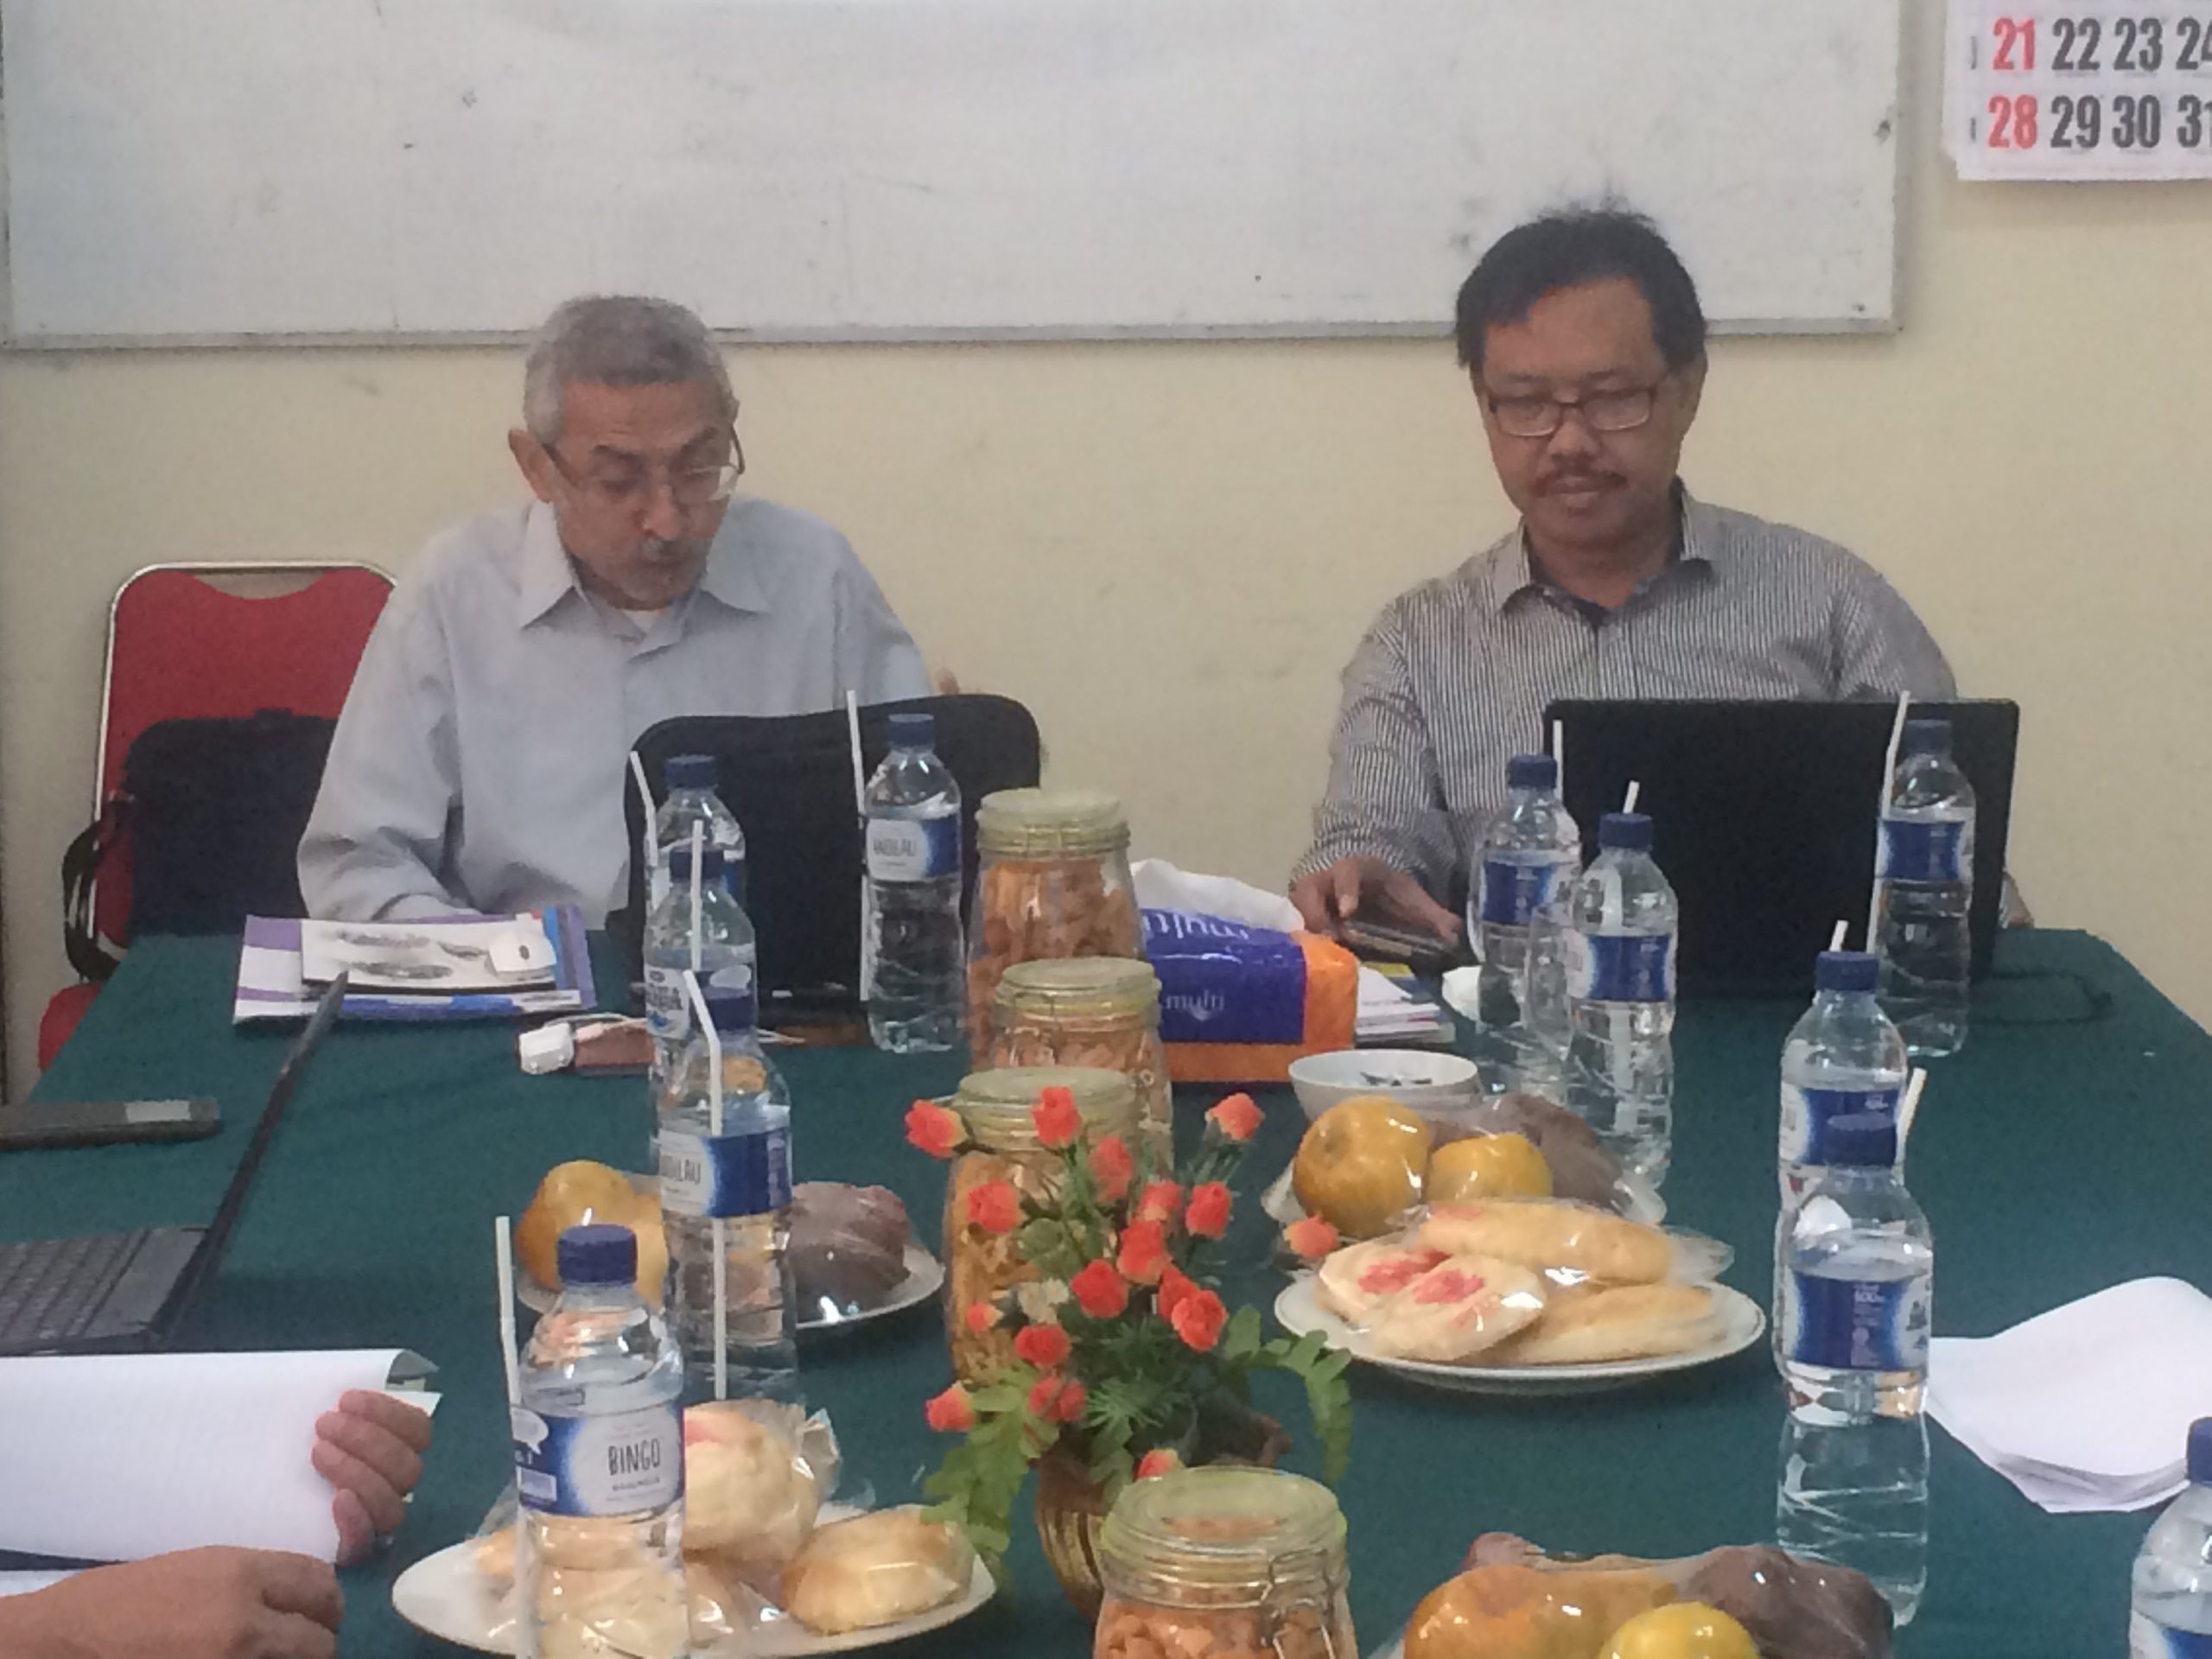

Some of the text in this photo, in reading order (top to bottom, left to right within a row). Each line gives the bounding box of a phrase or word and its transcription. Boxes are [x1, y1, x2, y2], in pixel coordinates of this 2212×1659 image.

[1992, 16, 2036, 71] 21
[2051, 17, 2101, 71] 22
[2113, 16, 2163, 72] 23
[1987, 94, 2037, 149] 28
[2050, 95, 2101, 149] 29
[2112, 94, 2161, 149] 30
[608, 1437, 660, 1476] BINGO
